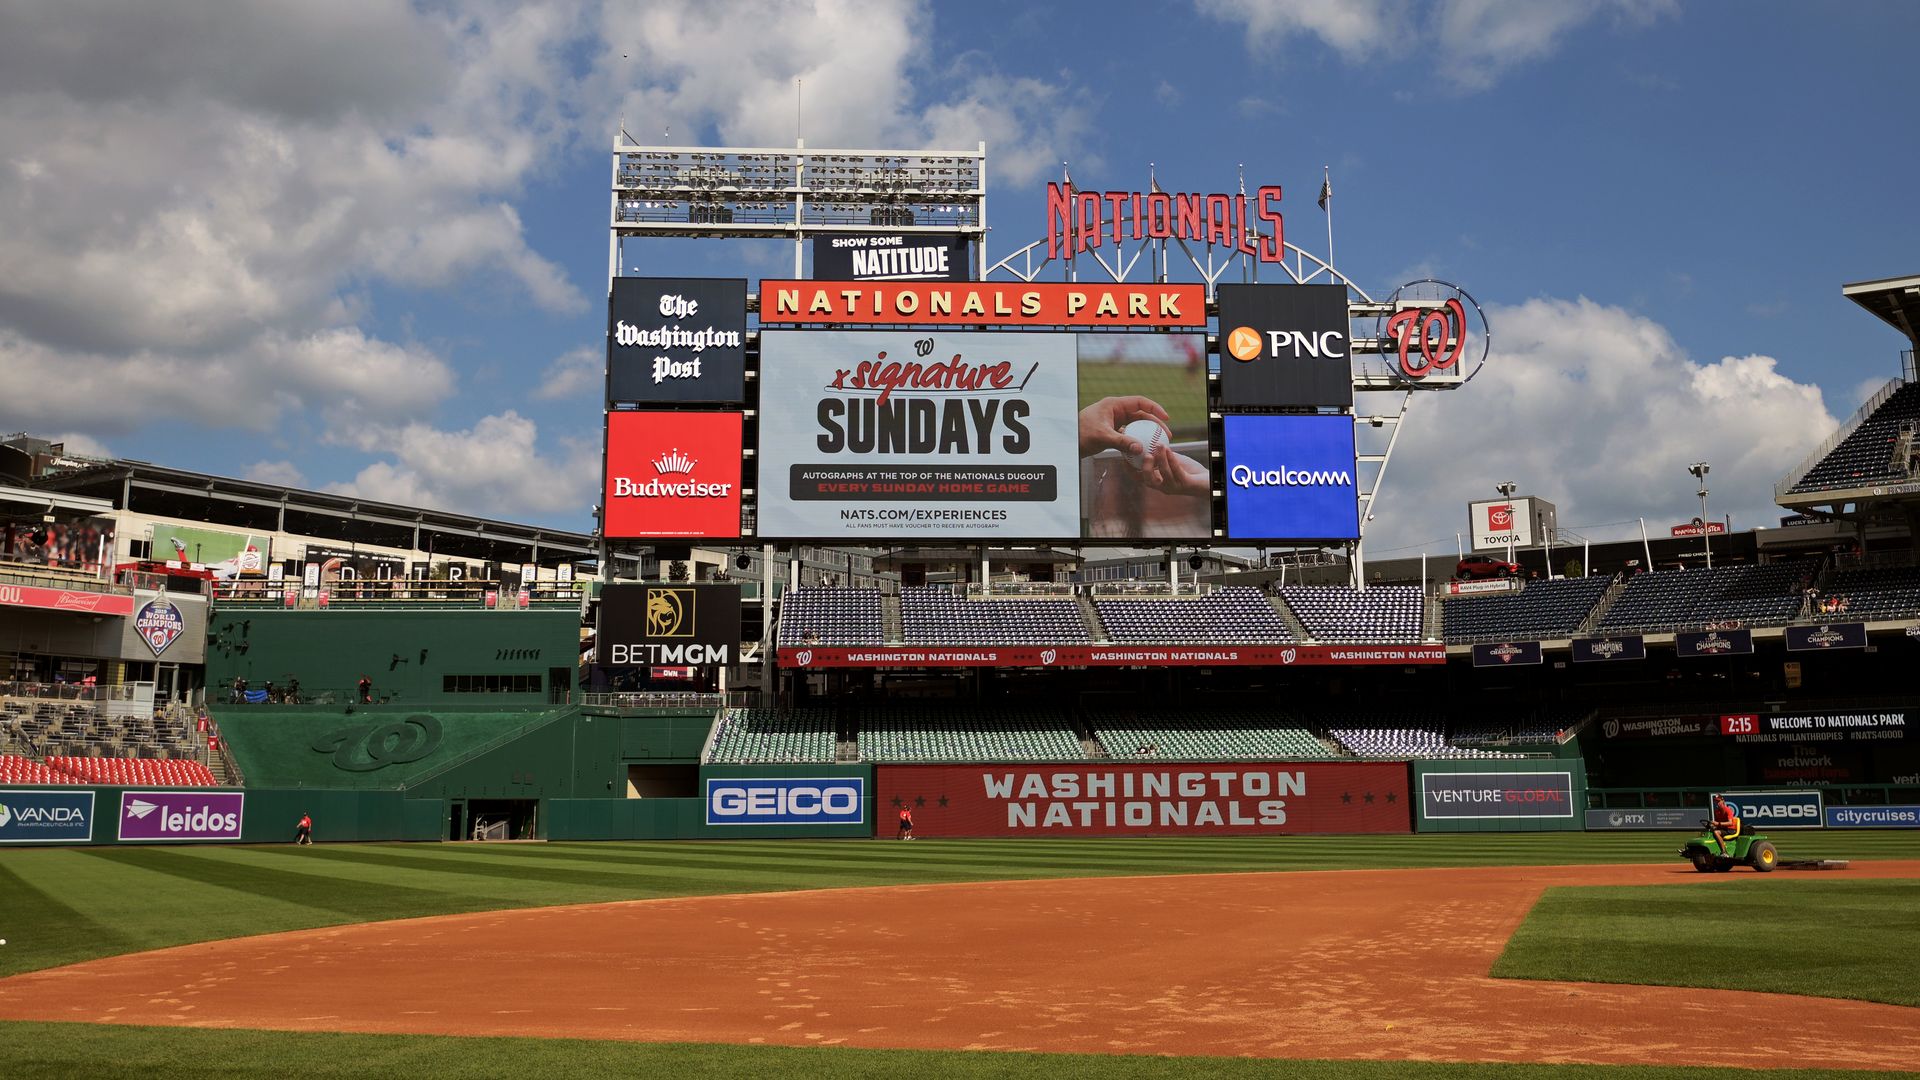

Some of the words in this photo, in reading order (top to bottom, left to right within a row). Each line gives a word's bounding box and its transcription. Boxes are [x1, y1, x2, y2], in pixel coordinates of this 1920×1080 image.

[1048, 182, 1284, 263] NATIONALS
[832, 238, 868, 248] SHOW
[871, 236, 903, 246] SOME
[853, 246, 949, 276] NATITUDE
[659, 295, 698, 319] The
[778, 289, 1041, 315] NATIONALS
[1068, 293, 1182, 316] PARK
[615, 321, 741, 352] Washington
[1267, 331, 1344, 358] PNC
[652, 356, 702, 384] Post
[851, 351, 1014, 406] signature
[817, 398, 1030, 454] SUNDAYS
[803, 472, 864, 480] AUTOGRAPHS
[866, 472, 877, 480] AT
[880, 472, 897, 480] THE
[900, 472, 918, 480] TOP
[920, 472, 932, 480] OF
[935, 472, 952, 480] THE
[954, 473, 1005, 481] NATIONALS
[1008, 473, 1045, 481] DUGOUT
[1232, 465, 1352, 489] Qualcomm
[614, 478, 732, 497] Budweiser
[818, 484, 869, 493] EVERY
[872, 484, 935, 493] SUNDAY
[939, 484, 983, 493] HOME
[987, 484, 1029, 493] GAME
[840, 509, 1007, 521] NATS.COM/EXPERIENCES
[1697, 525, 1721, 534] ROSTER
[1484, 535, 1521, 544] TOYOTA
[0, 586, 24, 603] OU.
[60, 595, 97, 606] Budweiser
[145, 611, 176, 621] WORLD
[138, 618, 182, 630] CHAMPIONS
[1696, 641, 1731, 651] CHAMPIONS
[1807, 635, 1844, 643] CHAMPIONS
[612, 644, 728, 664] BETMGM
[1592, 643, 1623, 654] CHAMPIONS
[848, 653, 926, 662] WASHINGTON
[929, 653, 997, 662] NATIONALS
[1092, 653, 1168, 661] WASHINGTON
[1171, 652, 1238, 661] NATIONALS
[1331, 651, 1404, 661] WASHINGTON
[1622, 718, 1681, 731] WASHINGTON
[1728, 717, 1751, 733] 2:15
[1770, 716, 1812, 729] WELCOME
[1814, 716, 1825, 728] TO
[1828, 714, 1878, 728] NATIONALS
[1880, 713, 1905, 726] PARK
[1651, 723, 1701, 736] NATIONALS
[1736, 733, 1777, 743] NATIONALS
[1779, 732, 1843, 742] PHILANTHROPIES
[1791, 744, 1817, 756] The
[1777, 754, 1832, 768] network
[982, 771, 1307, 798] WASHINGTON
[712, 787, 858, 815] GEICO
[1432, 789, 1502, 803] VENTURE
[13, 807, 85, 821] VANDA
[1007, 800, 1287, 827] NATIONALS
[1742, 804, 1818, 818] DABOS
[161, 805, 237, 832] leidos
[1625, 814, 1645, 823] RTX
